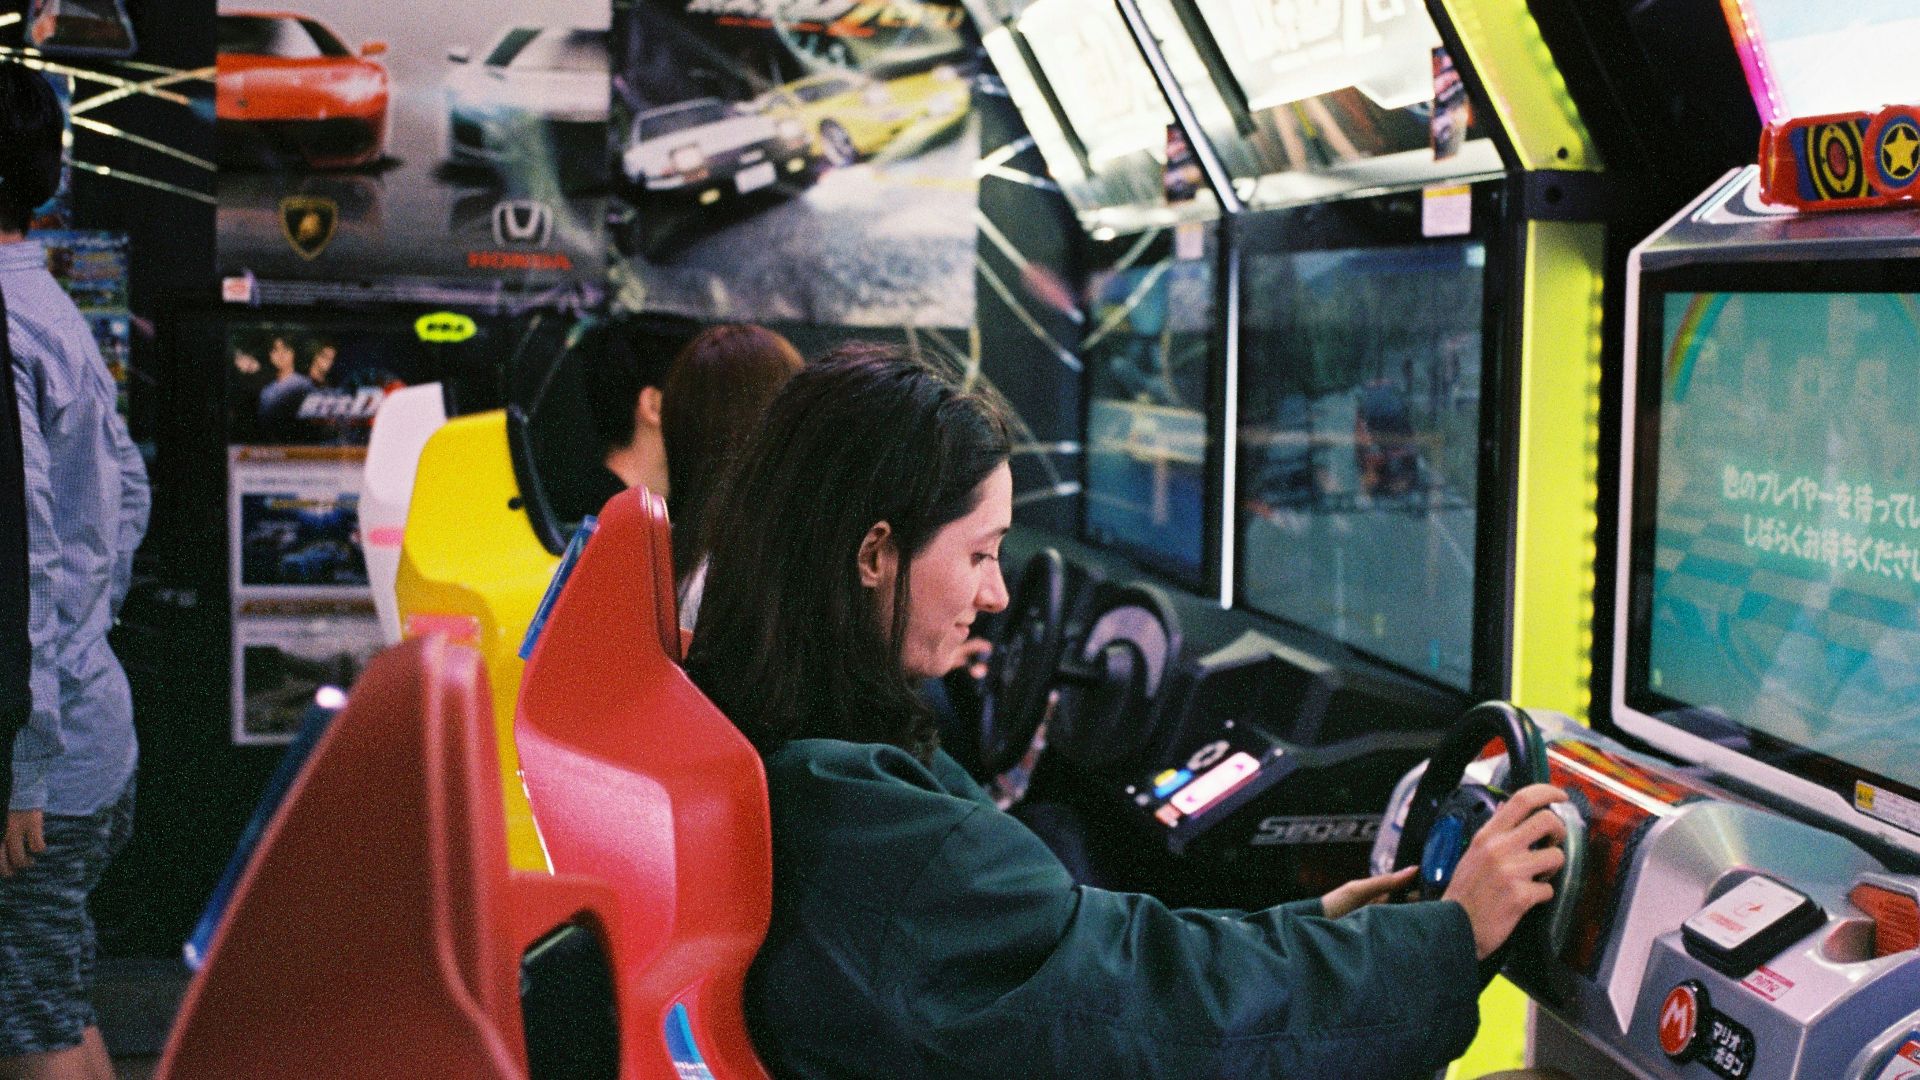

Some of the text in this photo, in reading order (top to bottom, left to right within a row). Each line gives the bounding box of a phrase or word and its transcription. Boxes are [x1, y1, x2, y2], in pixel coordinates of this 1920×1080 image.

[467, 251, 572, 270] HONDA
[1712, 1021, 1742, 1052] マリオ
[1714, 1048, 1745, 1077] ボタン
